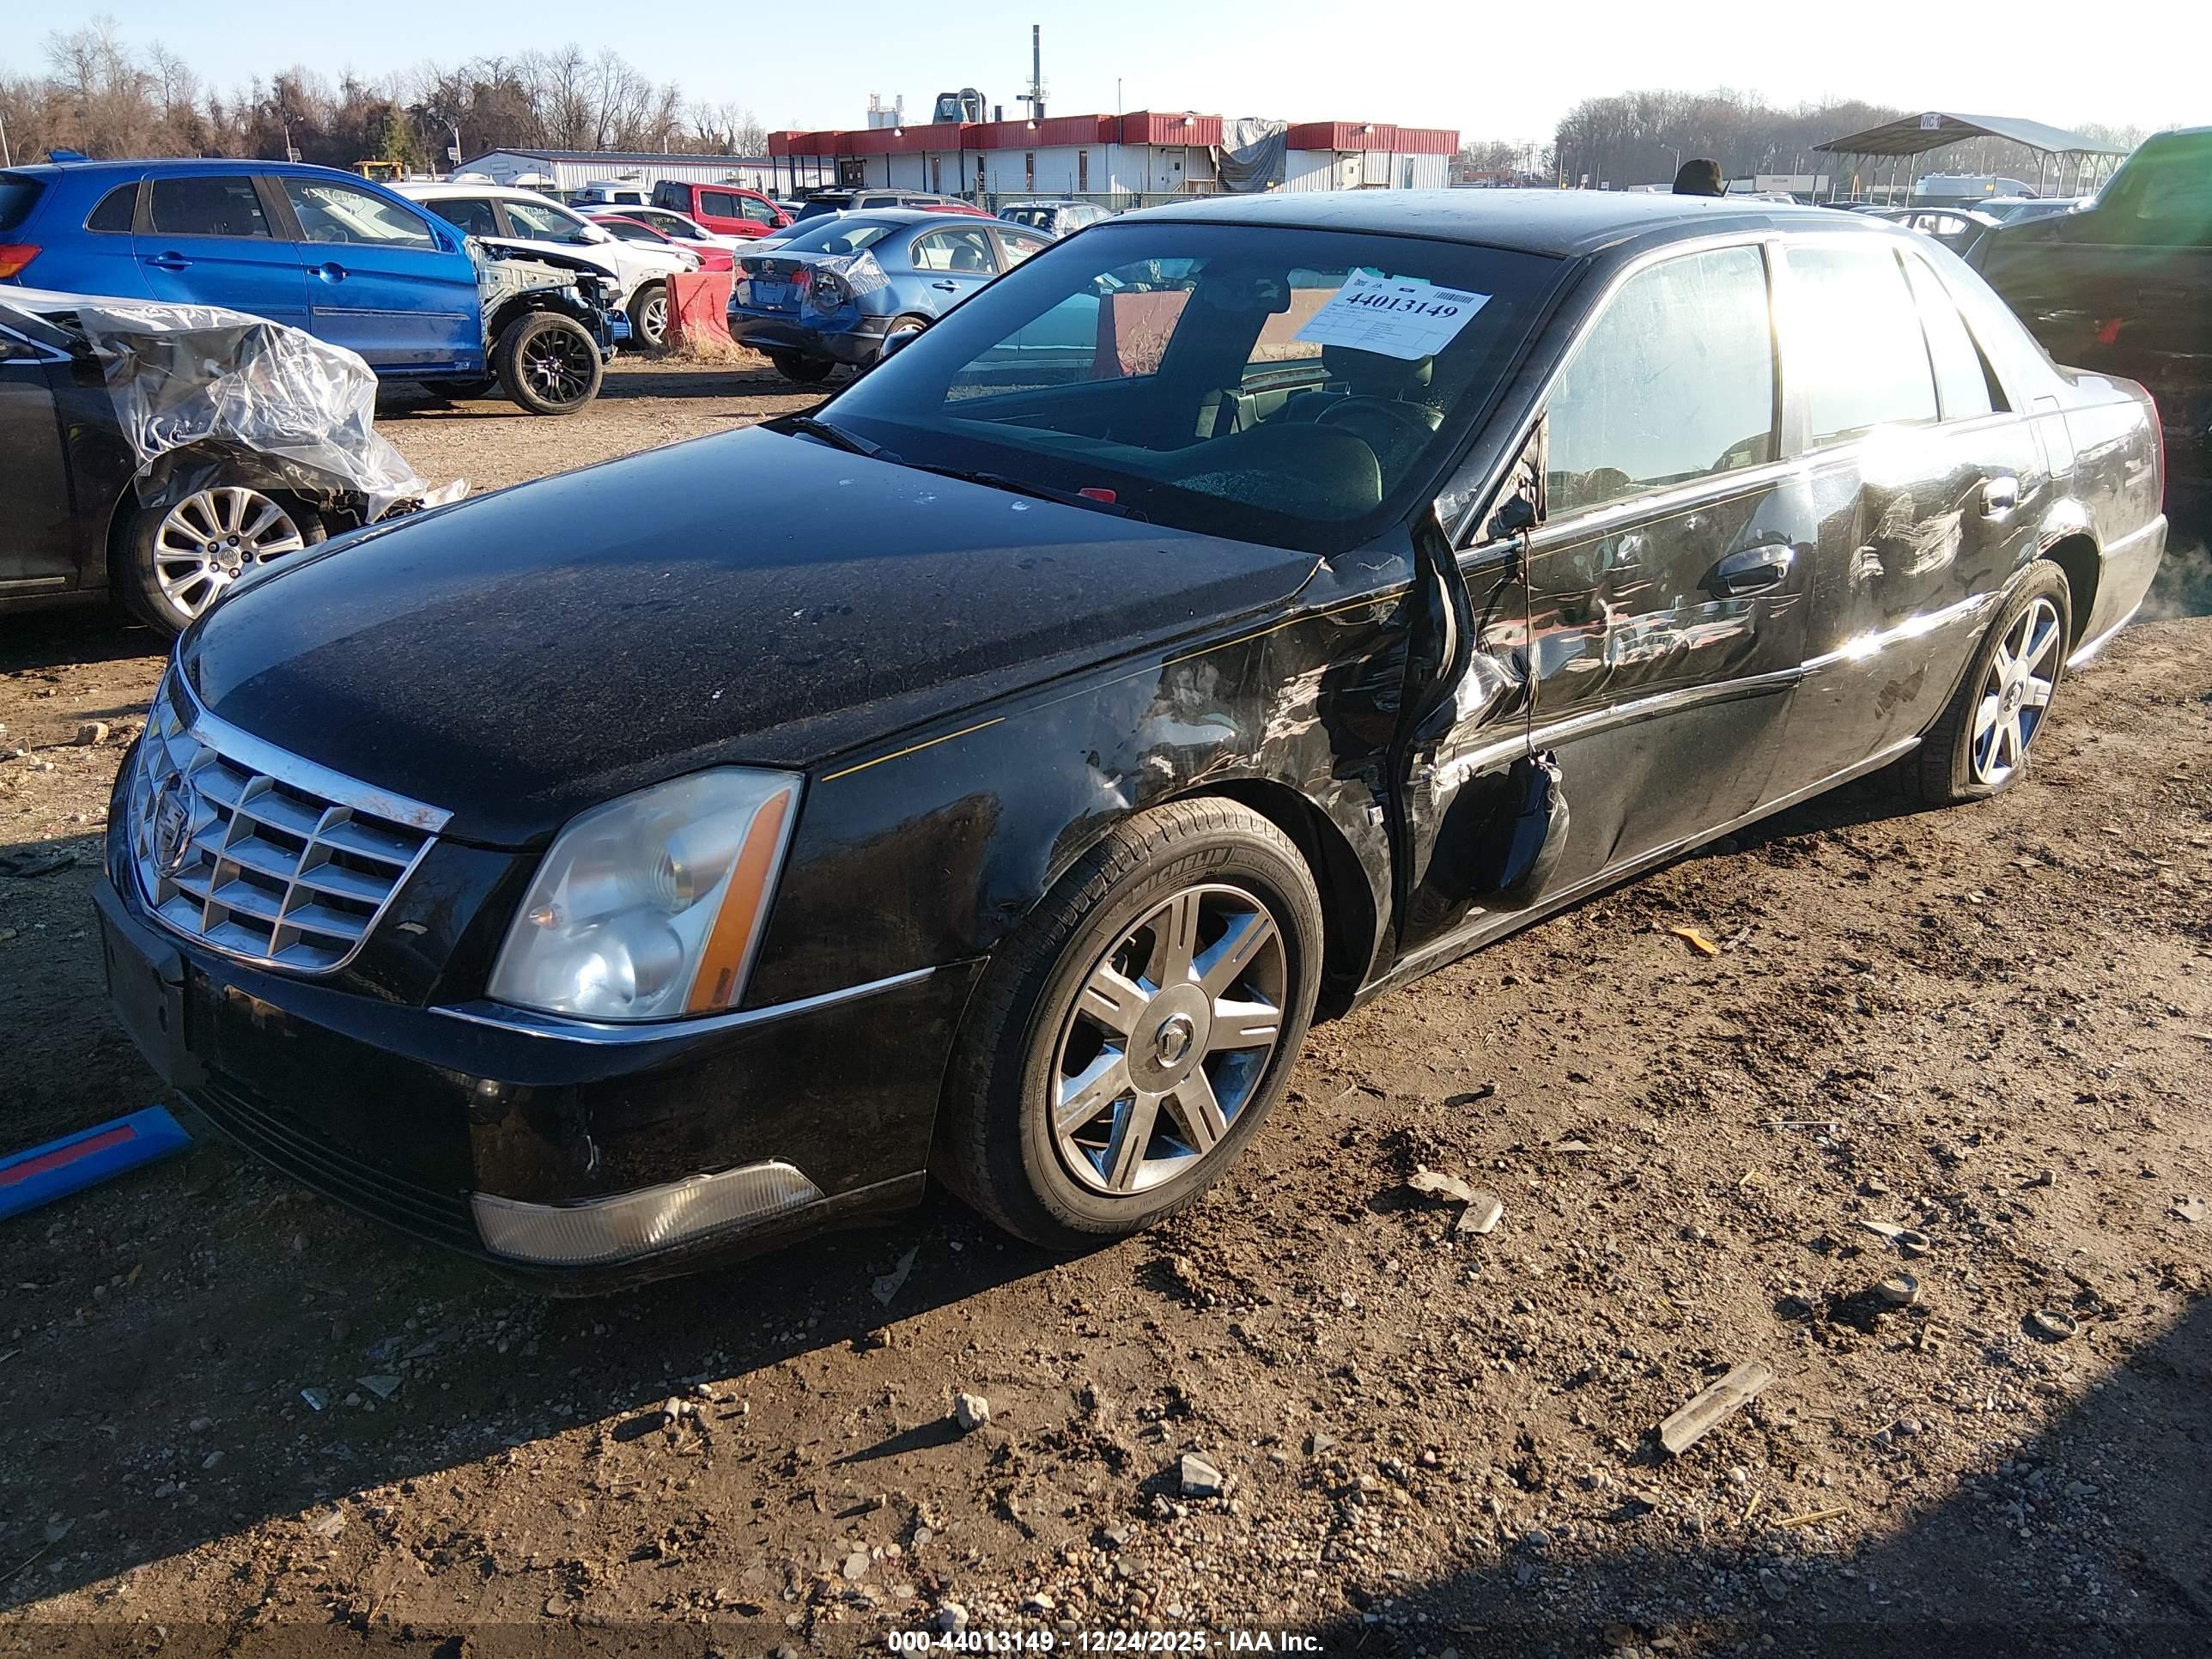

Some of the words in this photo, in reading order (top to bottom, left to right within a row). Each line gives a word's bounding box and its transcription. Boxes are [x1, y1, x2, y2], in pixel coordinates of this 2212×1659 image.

[1922, 116, 1934, 128] VIC
[1936, 116, 1941, 128] 1
[1346, 292, 1458, 318] 44013149
[1131, 847, 1233, 907] MICHELIN
